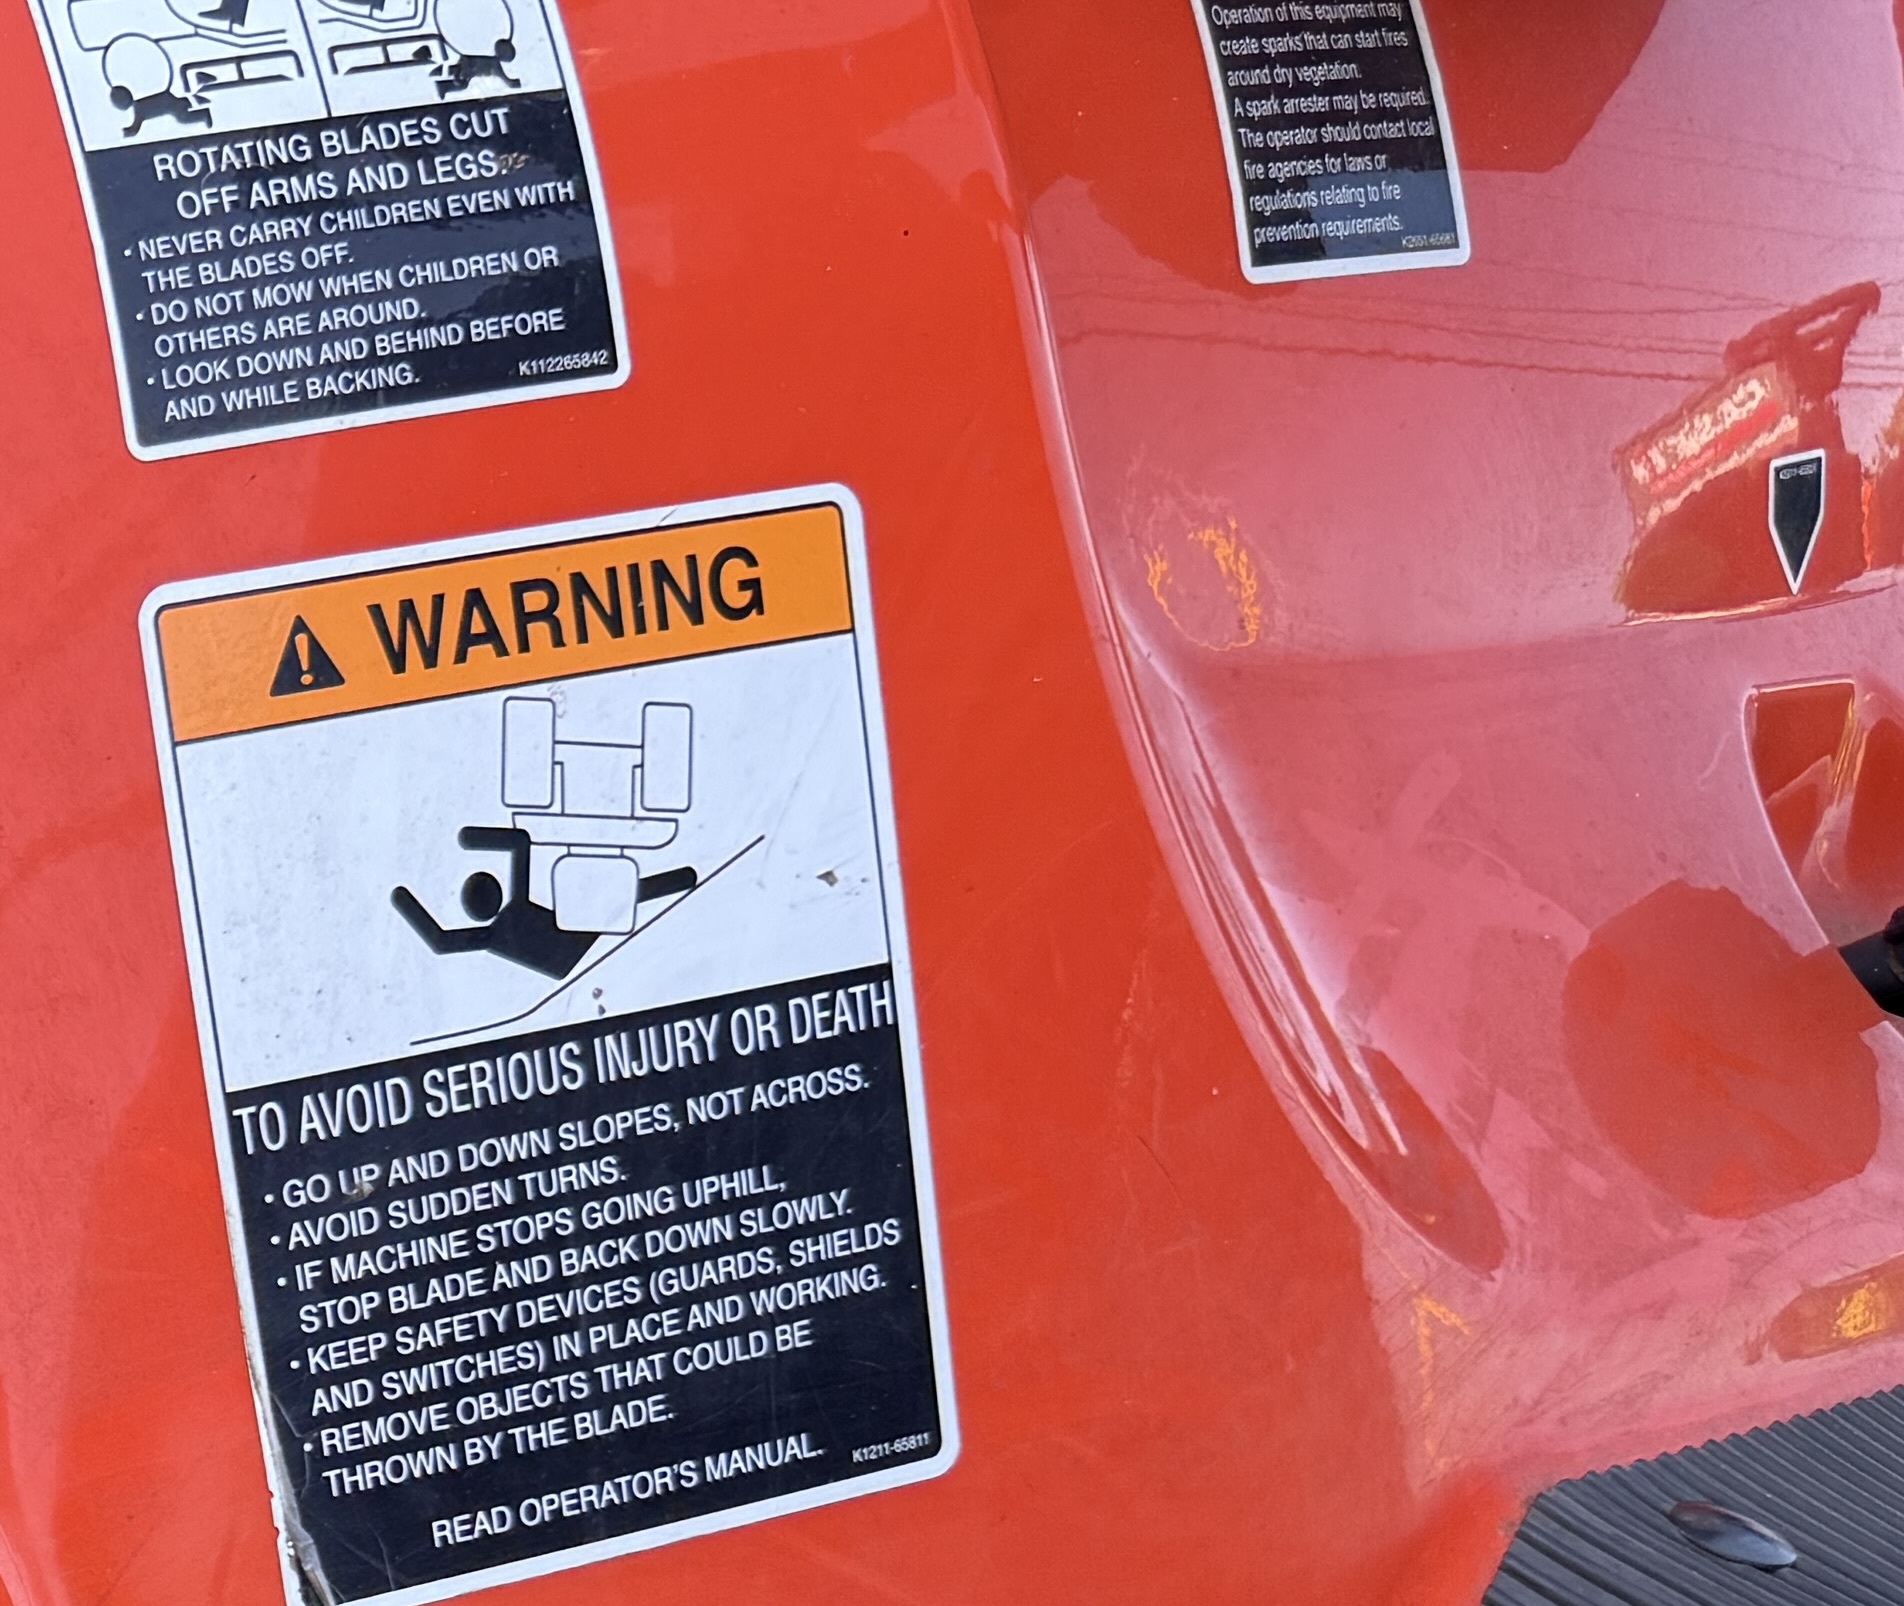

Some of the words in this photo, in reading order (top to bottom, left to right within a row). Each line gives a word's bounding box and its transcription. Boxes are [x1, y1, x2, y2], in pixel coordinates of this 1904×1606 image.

[1211, 3, 1274, 30] Operation
[1274, 1, 1289, 22] of
[1288, 1, 1314, 21] this
[1314, 1, 1377, 24] equipment
[1376, 2, 1402, 22] may
[1219, 35, 1260, 56] create
[1261, 32, 1304, 58] sparks
[1303, 31, 1330, 50] that
[1330, 33, 1353, 50] can
[1354, 31, 1382, 50] start
[1382, 28, 1410, 49] fires
[1227, 64, 1272, 87] around
[1273, 63, 1293, 89] dry
[1294, 60, 1362, 87] vegetation.
[1234, 97, 1245, 118] A
[1245, 95, 1282, 123] spark
[1282, 94, 1330, 114] arrester
[1332, 94, 1359, 115] may
[1359, 89, 1377, 109] be
[1378, 86, 1429, 112] required.
[153, 133, 313, 182] ROTATING
[319, 116, 442, 158] BLADES
[449, 107, 509, 141] CUT
[1237, 127, 1265, 148] The
[1265, 125, 1318, 152] operator
[1320, 121, 1362, 144] should
[1362, 119, 1407, 140] contact
[1406, 116, 1435, 137] local
[1243, 159, 1265, 180] fire
[1267, 158, 1324, 184] agencies
[1324, 152, 1342, 174] for
[1343, 152, 1373, 172] laws
[1374, 154, 1387, 170] or
[138, 229, 224, 262] NEVER
[229, 214, 313, 248] CARRY
[319, 197, 443, 235] CHILDREN
[446, 188, 511, 217] EVEN
[514, 180, 575, 207] WITH
[176, 184, 239, 219] OFF
[249, 170, 339, 210] ARMS
[346, 161, 409, 196] AND
[416, 148, 509, 187] LEGS.
[1249, 188, 1319, 216] regulations
[1319, 184, 1366, 208] relating
[1366, 184, 1380, 202] to
[1381, 180, 1401, 200] fire
[141, 265, 194, 294] THE
[198, 251, 296, 285] BLADES
[300, 242, 354, 270] OFF.
[1253, 218, 1320, 248] prevention
[1321, 212, 1404, 241] requirements.
[150, 299, 189, 326] DO
[194, 289, 245, 319] NOT
[252, 279, 314, 310] MOW
[318, 268, 393, 299] WHEN
[398, 251, 519, 288] CHILDREN
[523, 245, 560, 271] OR
[154, 321, 258, 358] OTHERS
[263, 313, 313, 341] ARE
[318, 298, 427, 333] AROUND.
[161, 357, 232, 390] LOOK
[236, 346, 314, 378] DOWN
[319, 337, 370, 365] AND
[374, 323, 465, 357] BEHIND
[469, 307, 566, 343] BEFORE
[164, 394, 216, 423] AND
[220, 380, 301, 413] WHILE
[305, 364, 420, 400] BACKING.
[367, 546, 765, 675] WARNING
[232, 1103, 288, 1158] TO
[299, 1076, 414, 1145] AVOID
[422, 1041, 586, 1118] SERIOUS
[593, 1013, 720, 1084] INJURY
[730, 1003, 782, 1056] OR
[789, 979, 896, 1045] DEATH
[282, 1173, 332, 1208] GO
[338, 1163, 382, 1198] UP
[388, 1149, 451, 1188] AND
[457, 1128, 552, 1173] DOWN
[558, 1103, 680, 1151] SLOPES,
[686, 1086, 746, 1125] NOT
[750, 1063, 870, 1112] ACROSS.
[288, 1206, 380, 1251] AVOID
[387, 1178, 514, 1229] SUDDEN
[517, 1155, 627, 1201] TURNS.
[294, 1259, 323, 1292] IF
[329, 1228, 471, 1284] MACHINE
[476, 1207, 575, 1253] STOPS
[581, 1185, 677, 1230] GOING
[682, 1165, 786, 1208] UPHILL,
[299, 1291, 382, 1334] STOP
[387, 1267, 489, 1314] BLADE
[492, 1254, 553, 1292] AND
[559, 1234, 640, 1277] BACK
[644, 1214, 734, 1259] DOWN
[739, 1188, 853, 1238] SLOWLY.
[306, 1332, 388, 1375] KEEP
[395, 1304, 510, 1355] SAFETY
[515, 1275, 643, 1328] DEVICES
[649, 1246, 783, 1305] (GUARDS,
[788, 1217, 901, 1268] SHIELDS
[311, 1378, 374, 1417] AND
[381, 1339, 546, 1401] SWITCHES)
[552, 1331, 583, 1362] IN
[588, 1308, 683, 1354] PLACE
[686, 1295, 745, 1332] AND
[749, 1263, 887, 1316] WORKING.
[320, 1402, 452, 1457] REMOVE
[456, 1370, 590, 1425] OBJECTS
[593, 1352, 668, 1393] THAT
[672, 1330, 769, 1376] COULD
[774, 1319, 813, 1352] BE
[321, 1443, 459, 1498] THROWN
[463, 1431, 503, 1466] BY
[507, 1417, 570, 1454] THE
[573, 1394, 674, 1441] BLADE.
[431, 1505, 513, 1548] READ
[704, 1432, 824, 1482] MANUAL.
